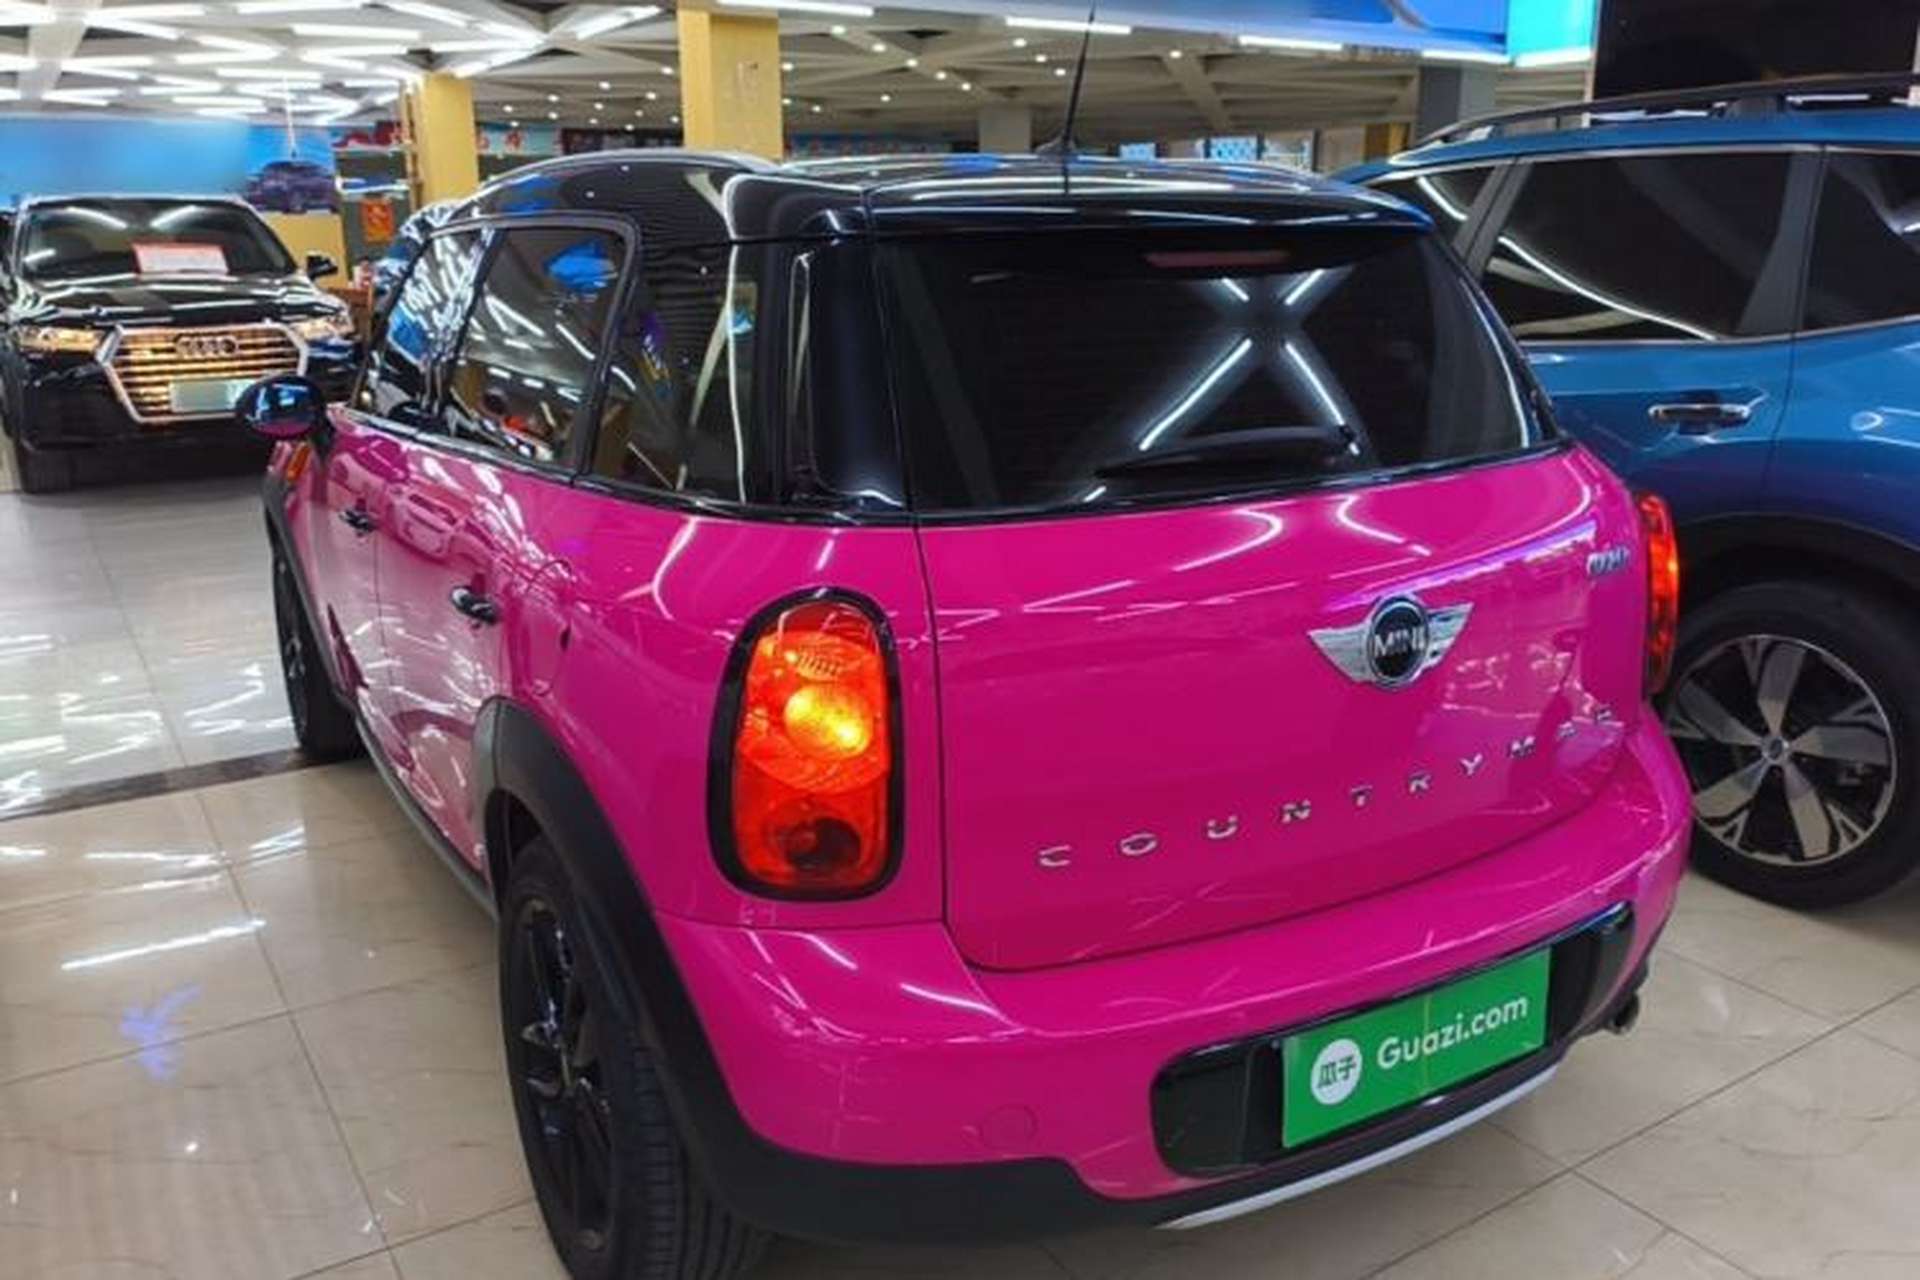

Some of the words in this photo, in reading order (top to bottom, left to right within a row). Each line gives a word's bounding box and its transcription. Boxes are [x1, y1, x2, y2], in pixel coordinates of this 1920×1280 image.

[1374, 626, 1425, 657] MINI
[1376, 997, 1529, 1070] Guazi.com
[1317, 1055, 1358, 1089] 瓜子
